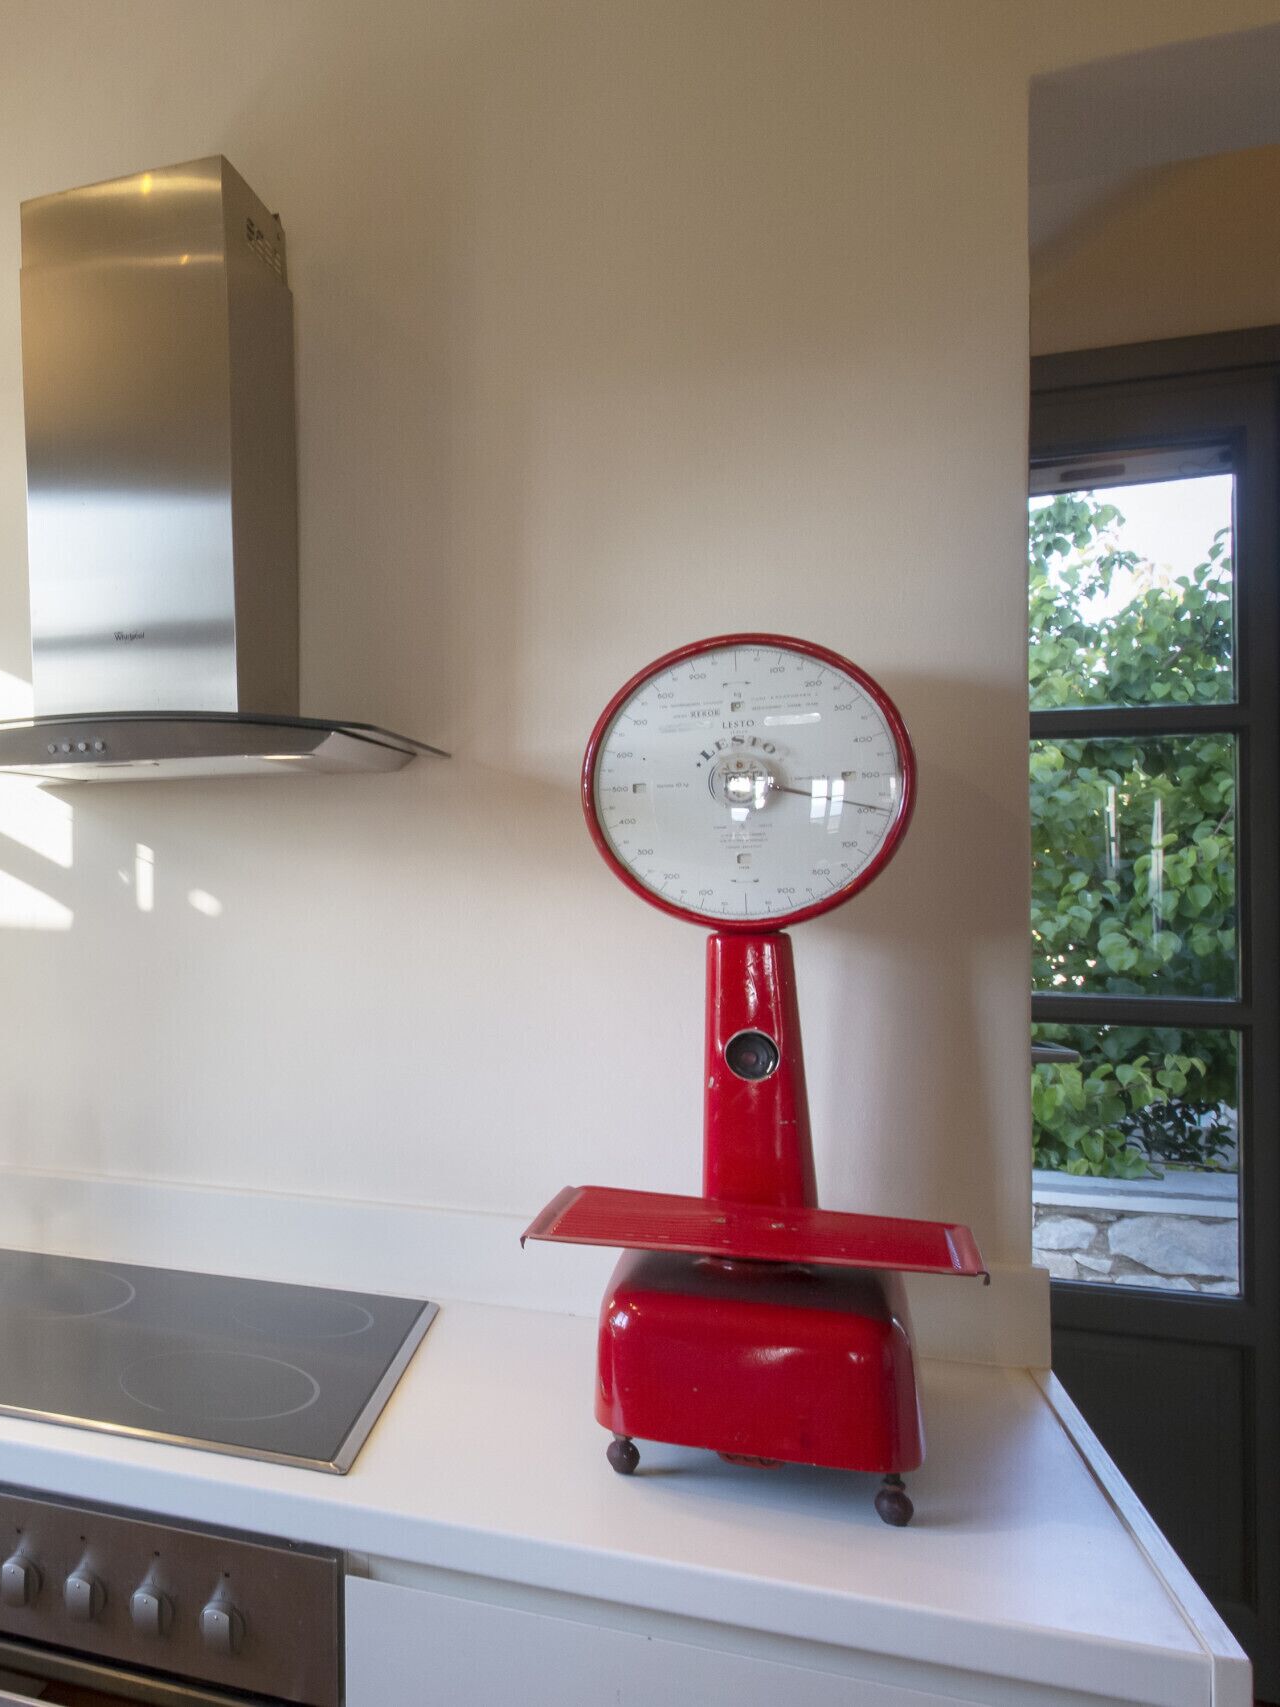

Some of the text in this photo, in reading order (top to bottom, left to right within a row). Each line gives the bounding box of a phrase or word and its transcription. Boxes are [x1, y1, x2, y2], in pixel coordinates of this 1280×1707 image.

[804, 680, 823, 688] 200
[722, 720, 755, 729] LESTO
[853, 735, 873, 743] 400
[700, 735, 776, 761] LESTO
[618, 817, 637, 825] 400
[842, 840, 858, 848] 700
[698, 888, 714, 896] 100
[776, 886, 796, 894] 900
